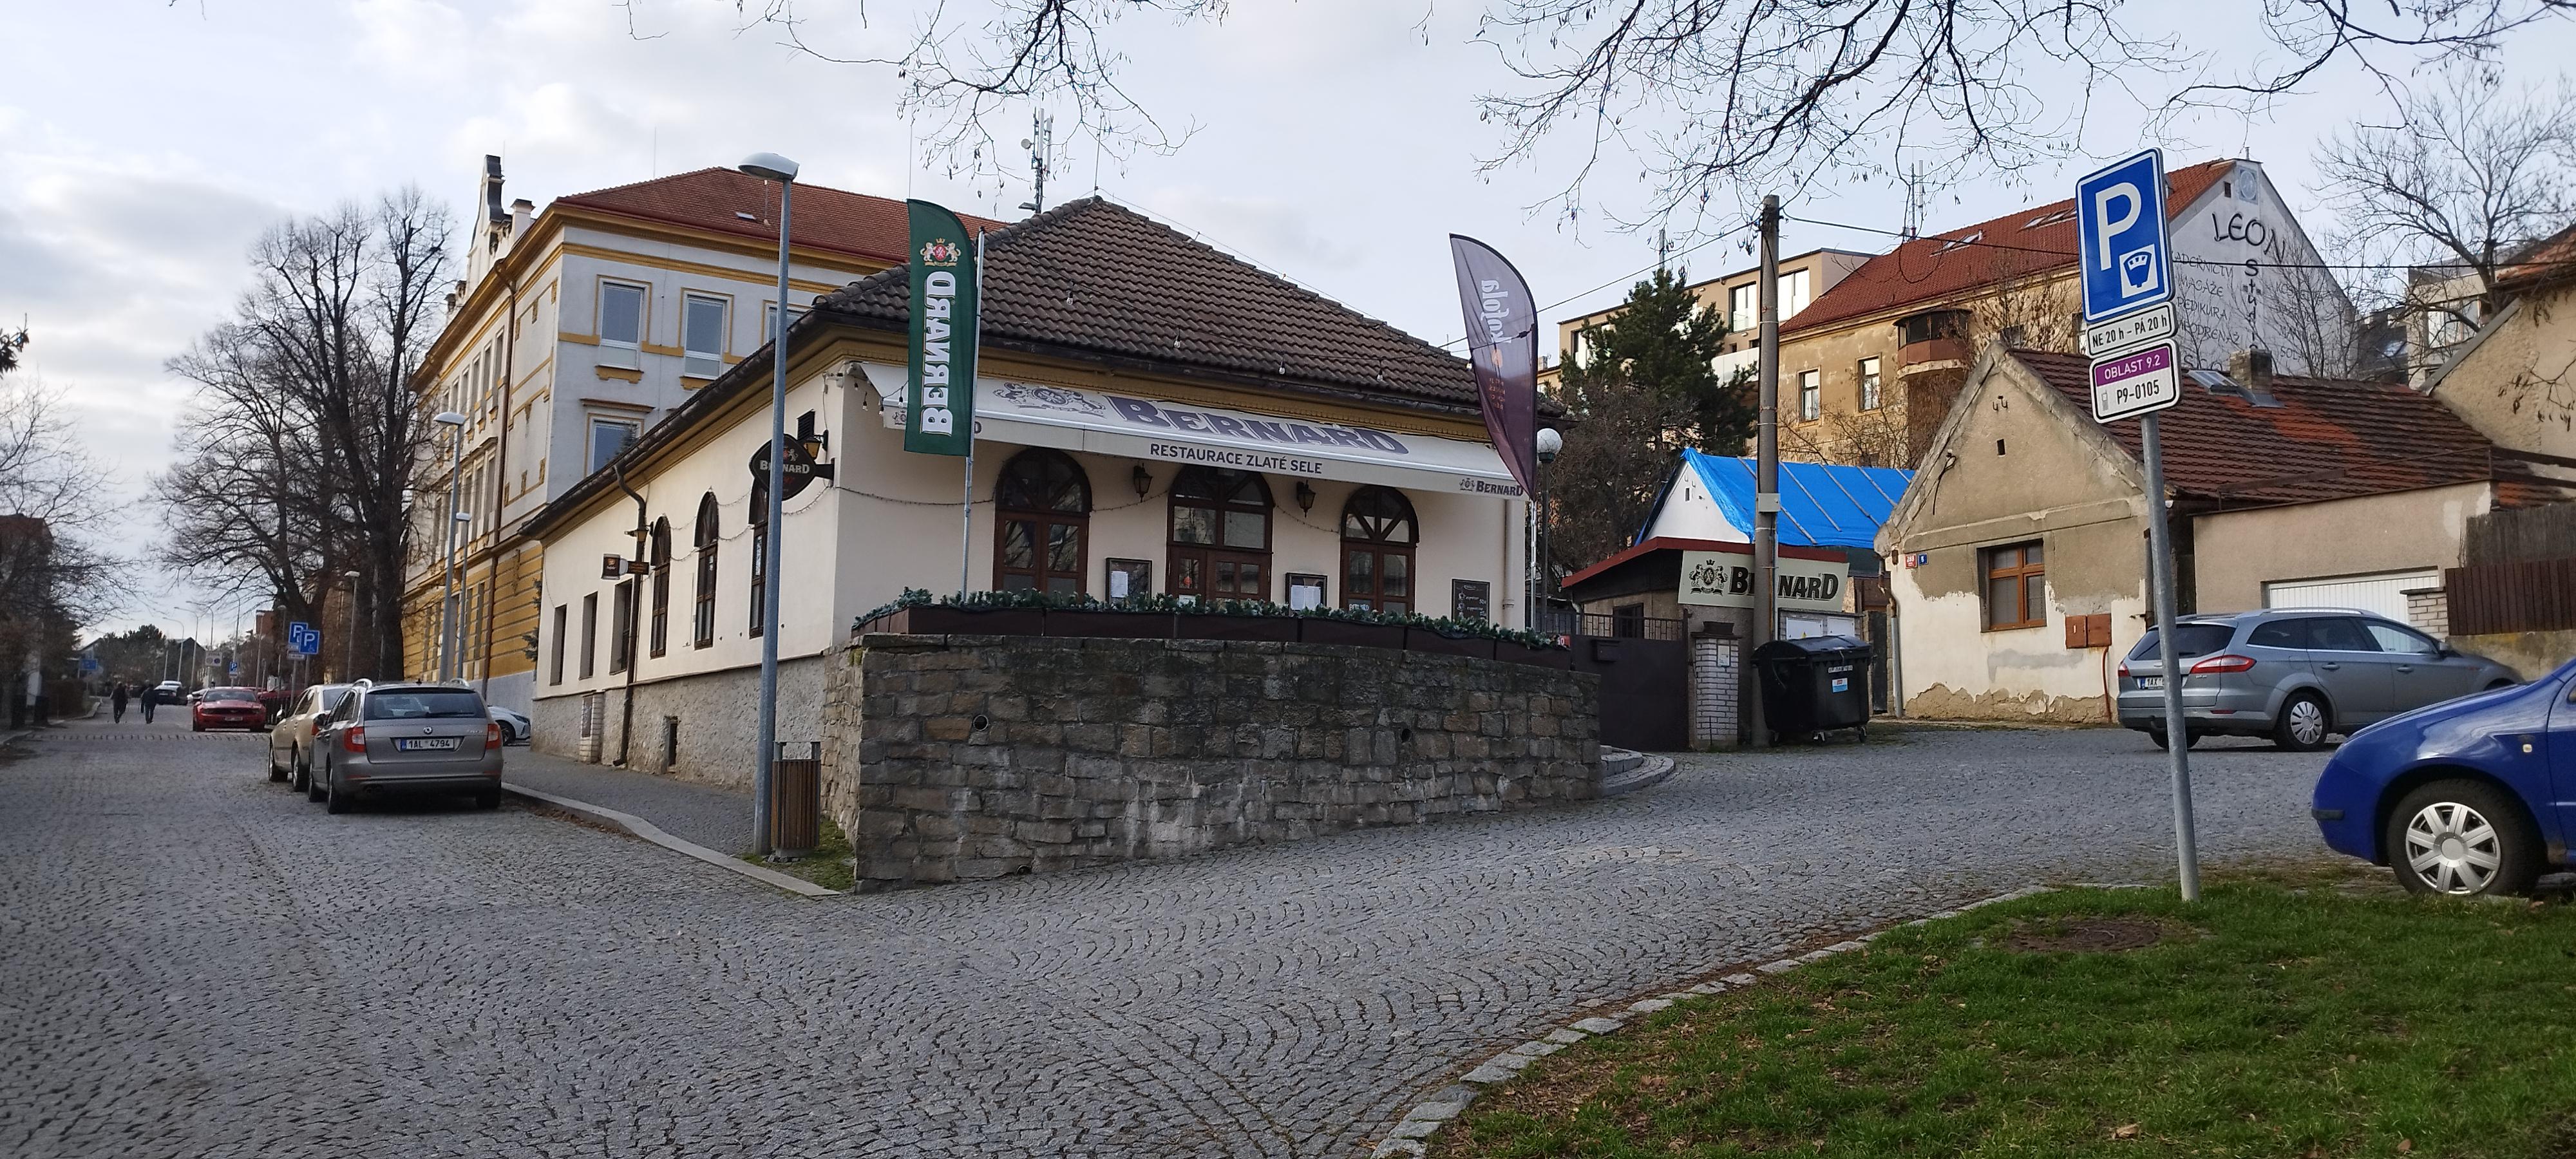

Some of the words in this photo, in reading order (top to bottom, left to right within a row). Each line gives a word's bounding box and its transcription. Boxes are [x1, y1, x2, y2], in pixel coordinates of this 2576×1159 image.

[2096, 182, 2141, 270] P
[2211, 212, 2286, 264] LEON
[2092, 333, 2104, 348] NE
[2105, 329, 2116, 343] 20
[2119, 328, 2125, 340] h
[2135, 317, 2146, 335] PÁ
[2148, 317, 2159, 332] 20
[2161, 314, 2168, 328] h
[2104, 359, 2143, 380] OBLAST
[2146, 355, 2161, 368] 9.2
[2117, 379, 2160, 404] P9-0105
[1106, 395, 1409, 455] BERNARD
[760, 460, 810, 474] BNARD
[1150, 443, 1243, 466] RESTAURACE
[1245, 454, 1287, 471] ZLATÉ
[1290, 460, 1323, 474] SELE
[1475, 480, 1524, 496] BERNARD
[1728, 566, 1839, 601] BNARD
[304, 633, 315, 646] P
